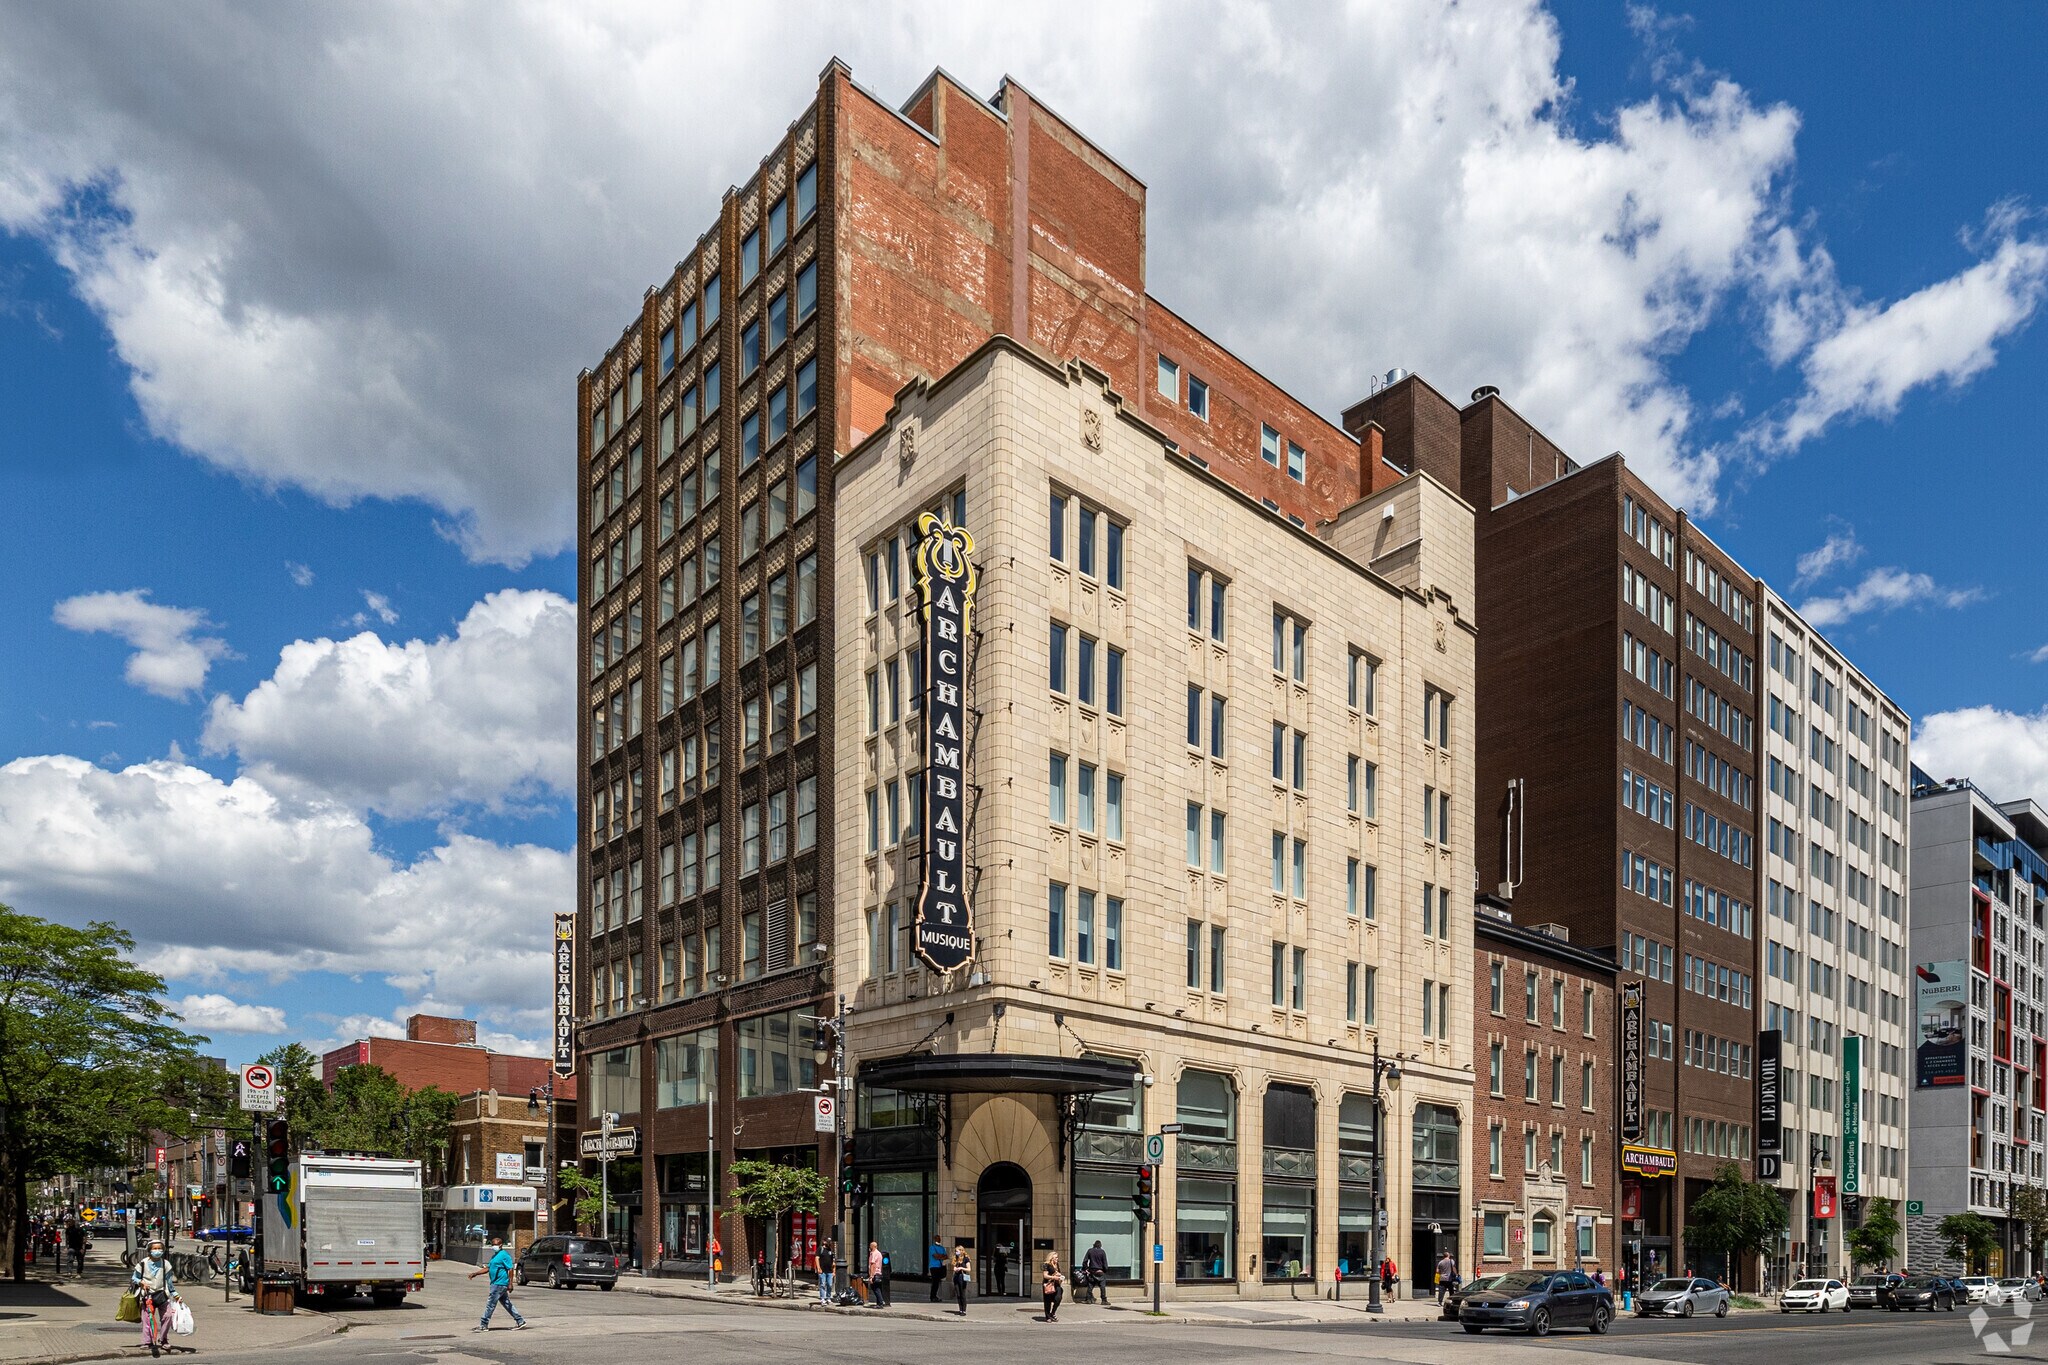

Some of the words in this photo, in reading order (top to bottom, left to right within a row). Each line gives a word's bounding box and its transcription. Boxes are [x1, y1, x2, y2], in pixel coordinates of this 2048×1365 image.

[935, 585, 958, 924] ARCHAMBAULT
[921, 930, 970, 951] MUSIQUE
[557, 941, 571, 1058] ARCHAMBAULT
[1625, 1009, 1638, 1122] ARCHAMBAULT
[1761, 1057, 1776, 1103] DEVOIR
[1761, 1105, 1776, 1121] LE
[1625, 1152, 1675, 1168] ARCHAMBAULT
[1762, 1157, 1776, 1176] D
[1847, 1140, 1856, 1179] Desjardins
